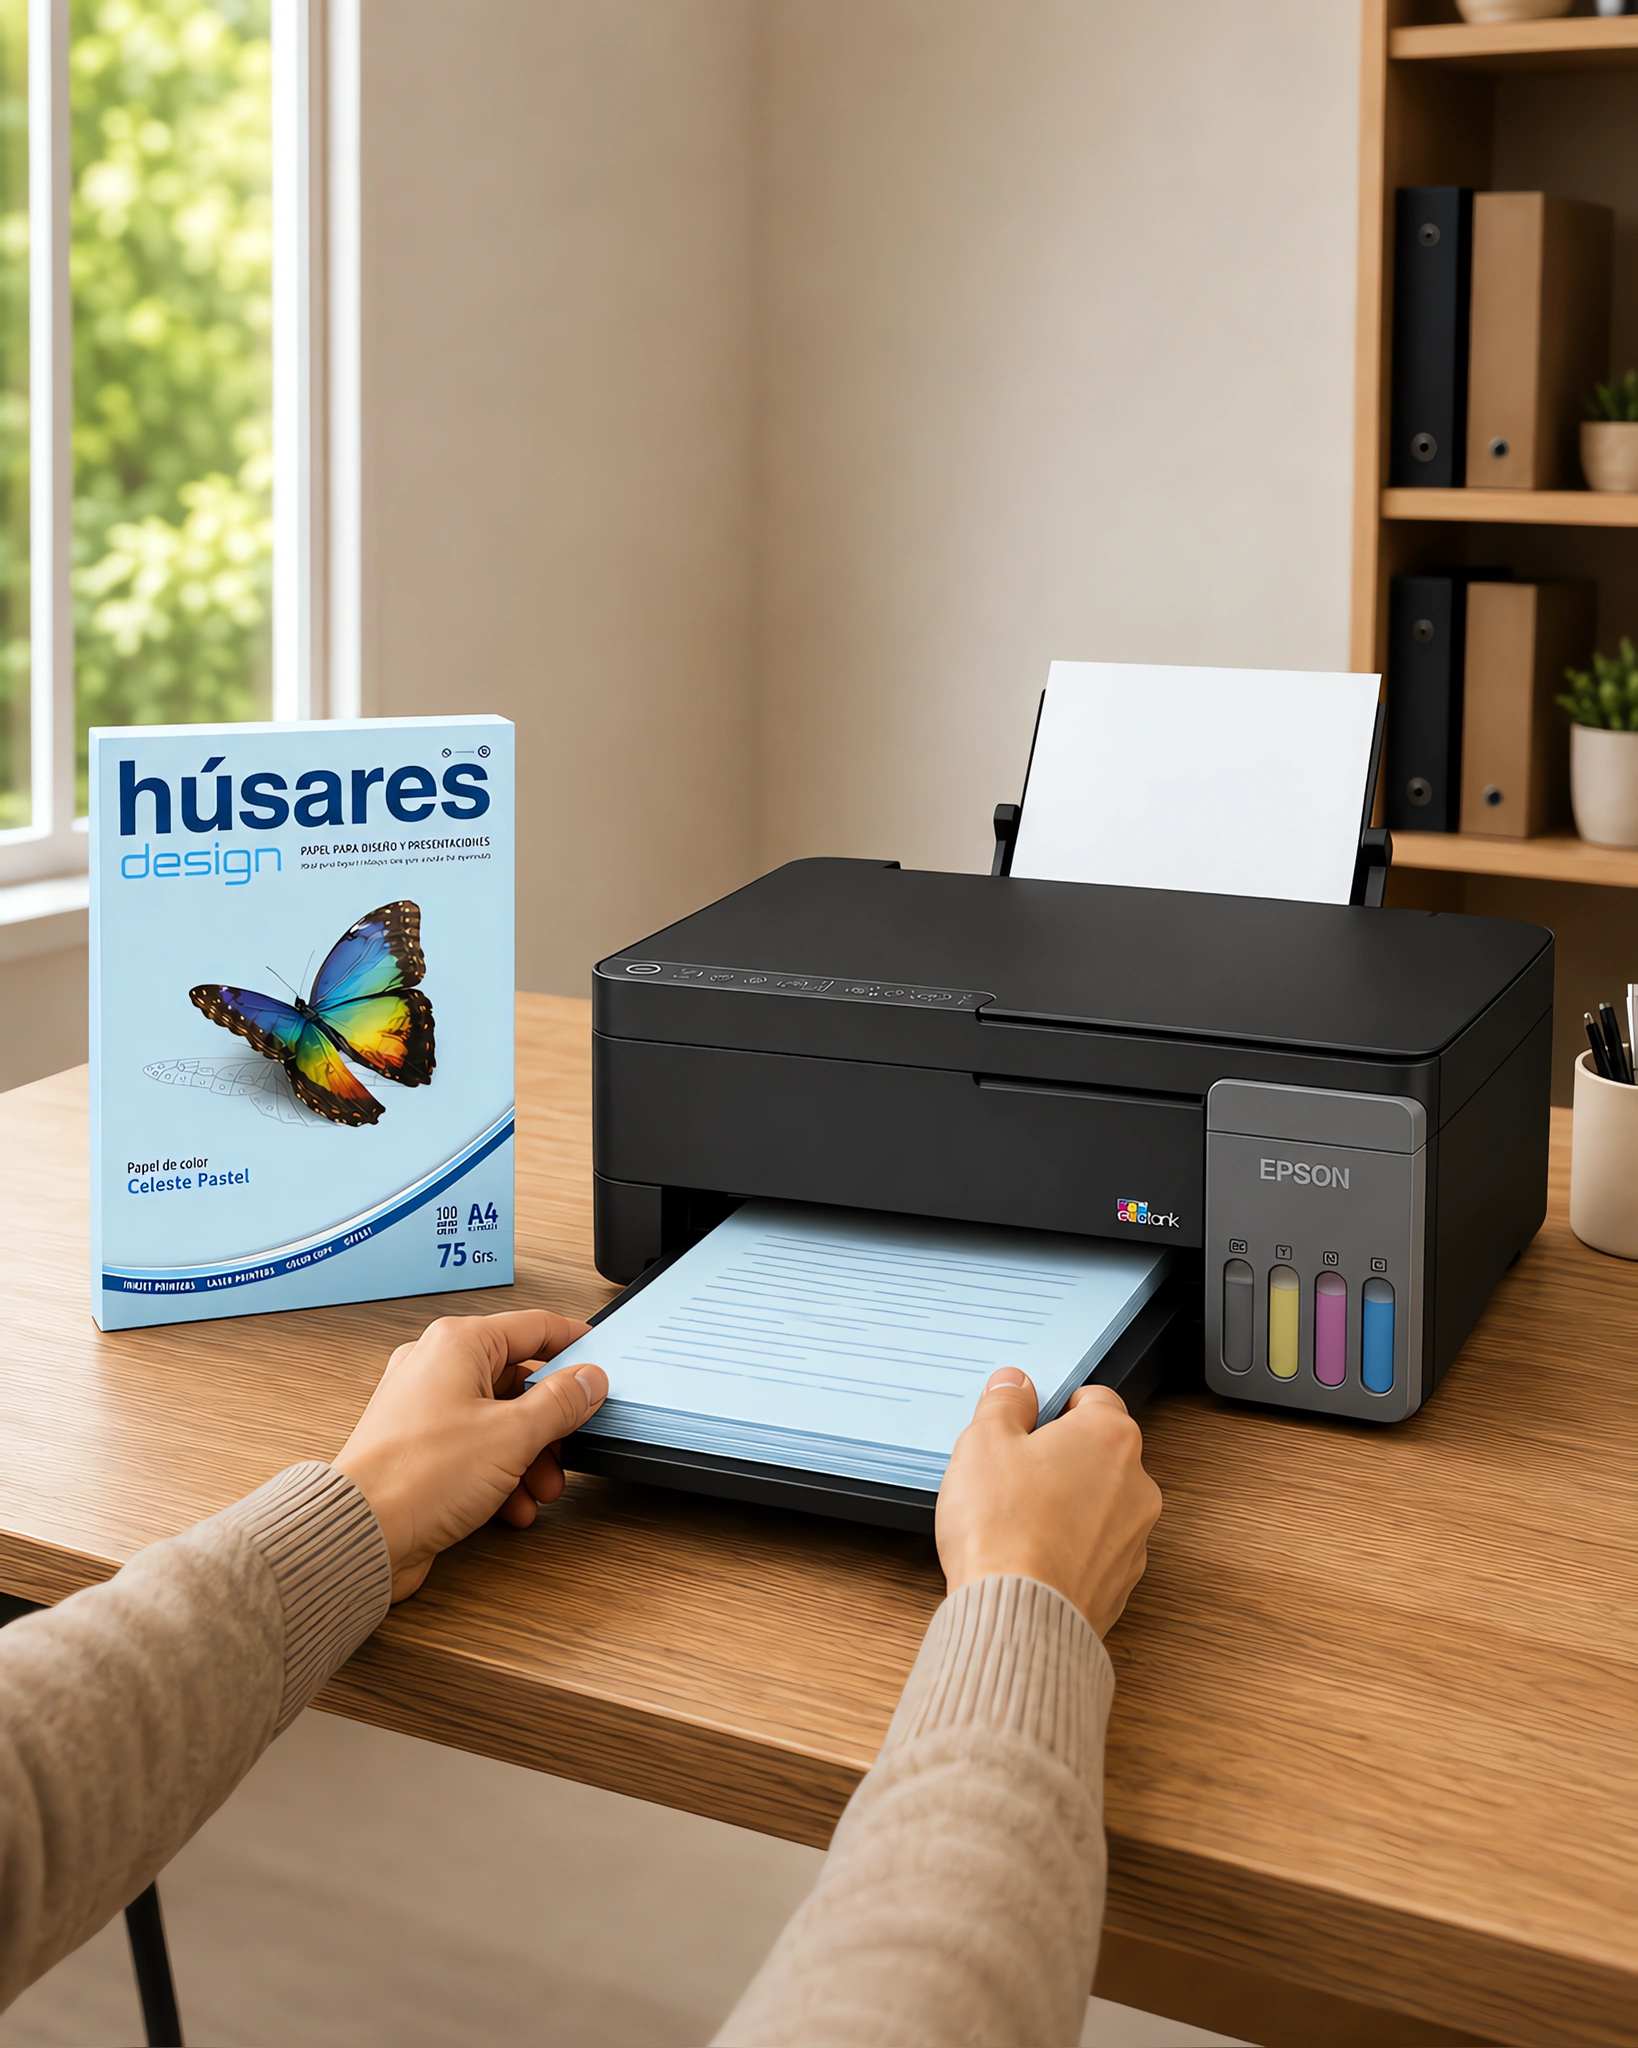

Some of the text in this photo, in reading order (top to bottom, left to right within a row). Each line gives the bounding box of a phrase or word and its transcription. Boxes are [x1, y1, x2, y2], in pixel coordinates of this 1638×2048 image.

[119, 756, 491, 836] húsares
[300, 845, 330, 856] PAPEL
[399, 841, 407, 851] Y
[121, 842, 282, 886] design
[127, 1156, 209, 1175] Papel de color
[1259, 1158, 1350, 1190] EPSON
[127, 1168, 250, 1195] Celeste Pastel
[436, 1205, 458, 1220] 100
[467, 1201, 499, 1225] A4
[437, 1241, 498, 1269] 75 Grs.
